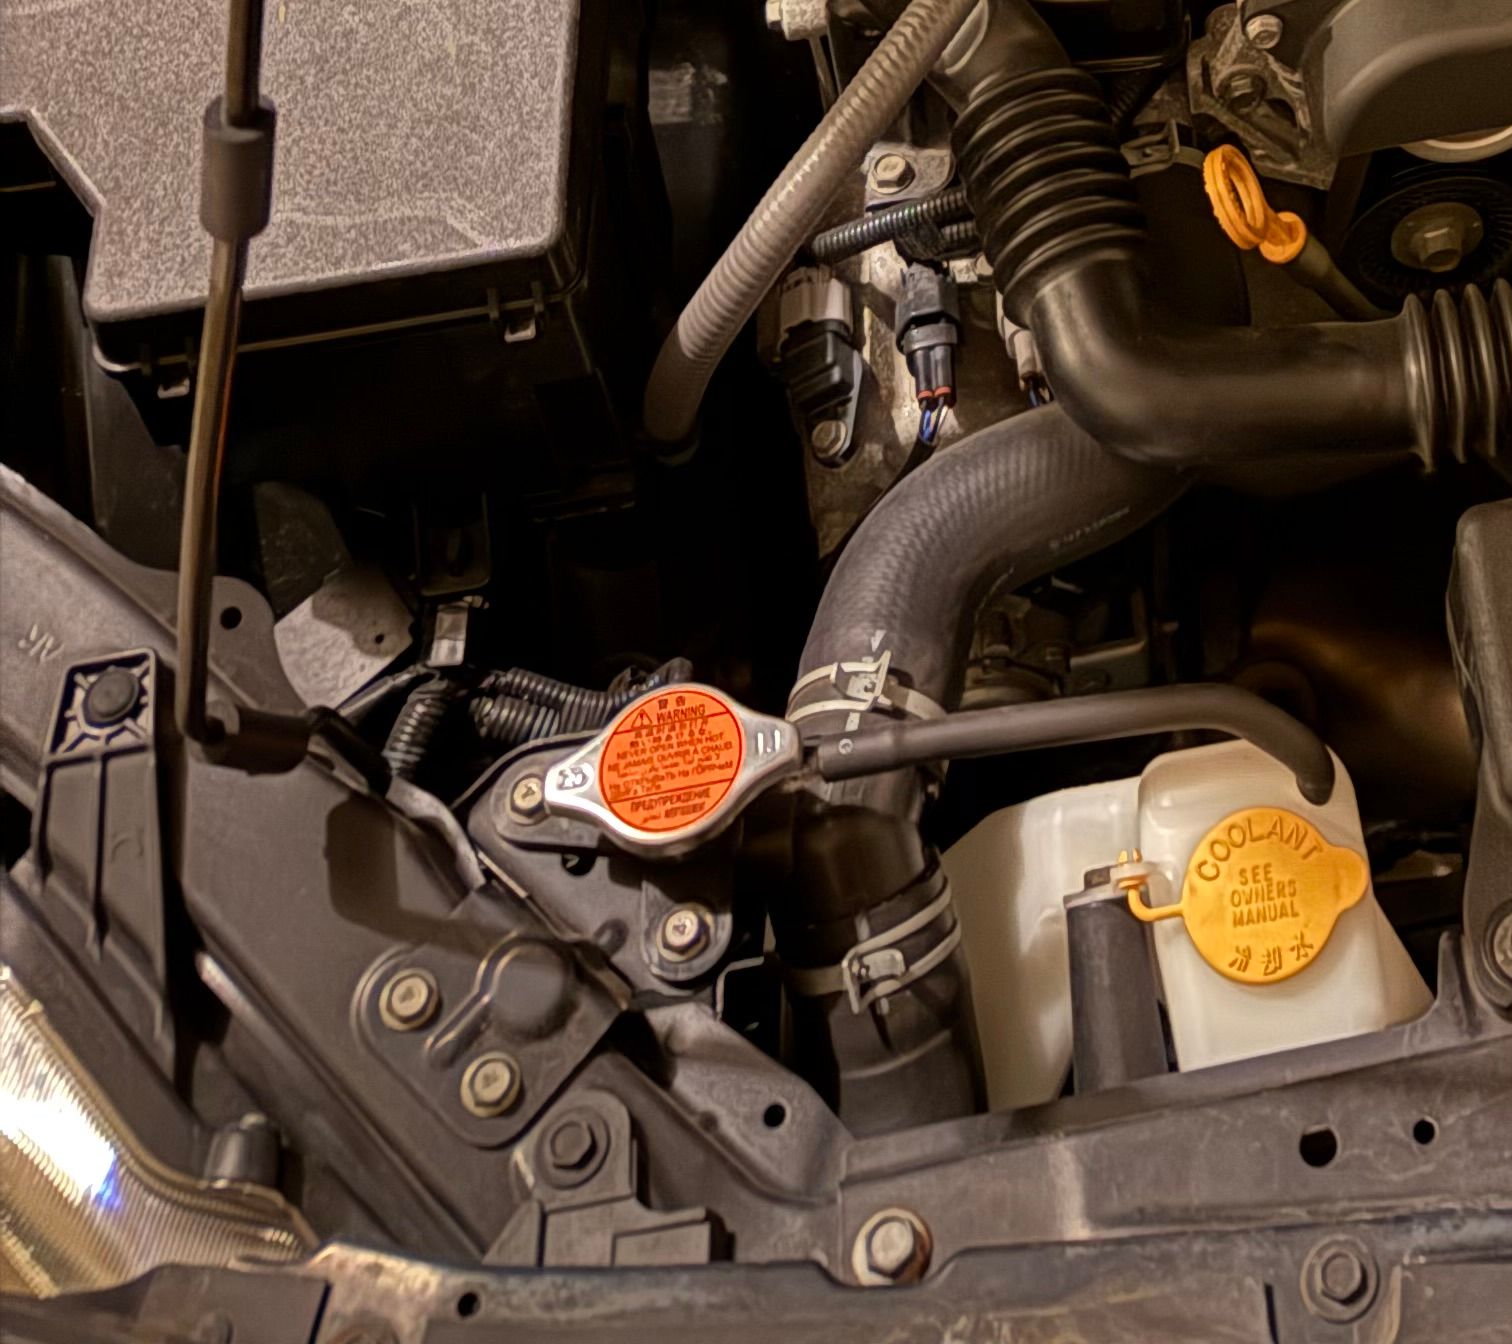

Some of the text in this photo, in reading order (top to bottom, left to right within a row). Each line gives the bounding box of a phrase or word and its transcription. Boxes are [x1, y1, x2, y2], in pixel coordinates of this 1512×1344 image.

[656, 703, 706, 724] WARNING
[649, 743, 674, 754] OPEN
[705, 732, 724, 743] HOT
[1196, 815, 1323, 882] COOLANT
[1239, 862, 1273, 887] SEE
[1230, 880, 1297, 908] OWNERS
[1232, 901, 1300, 929] MANUAL
